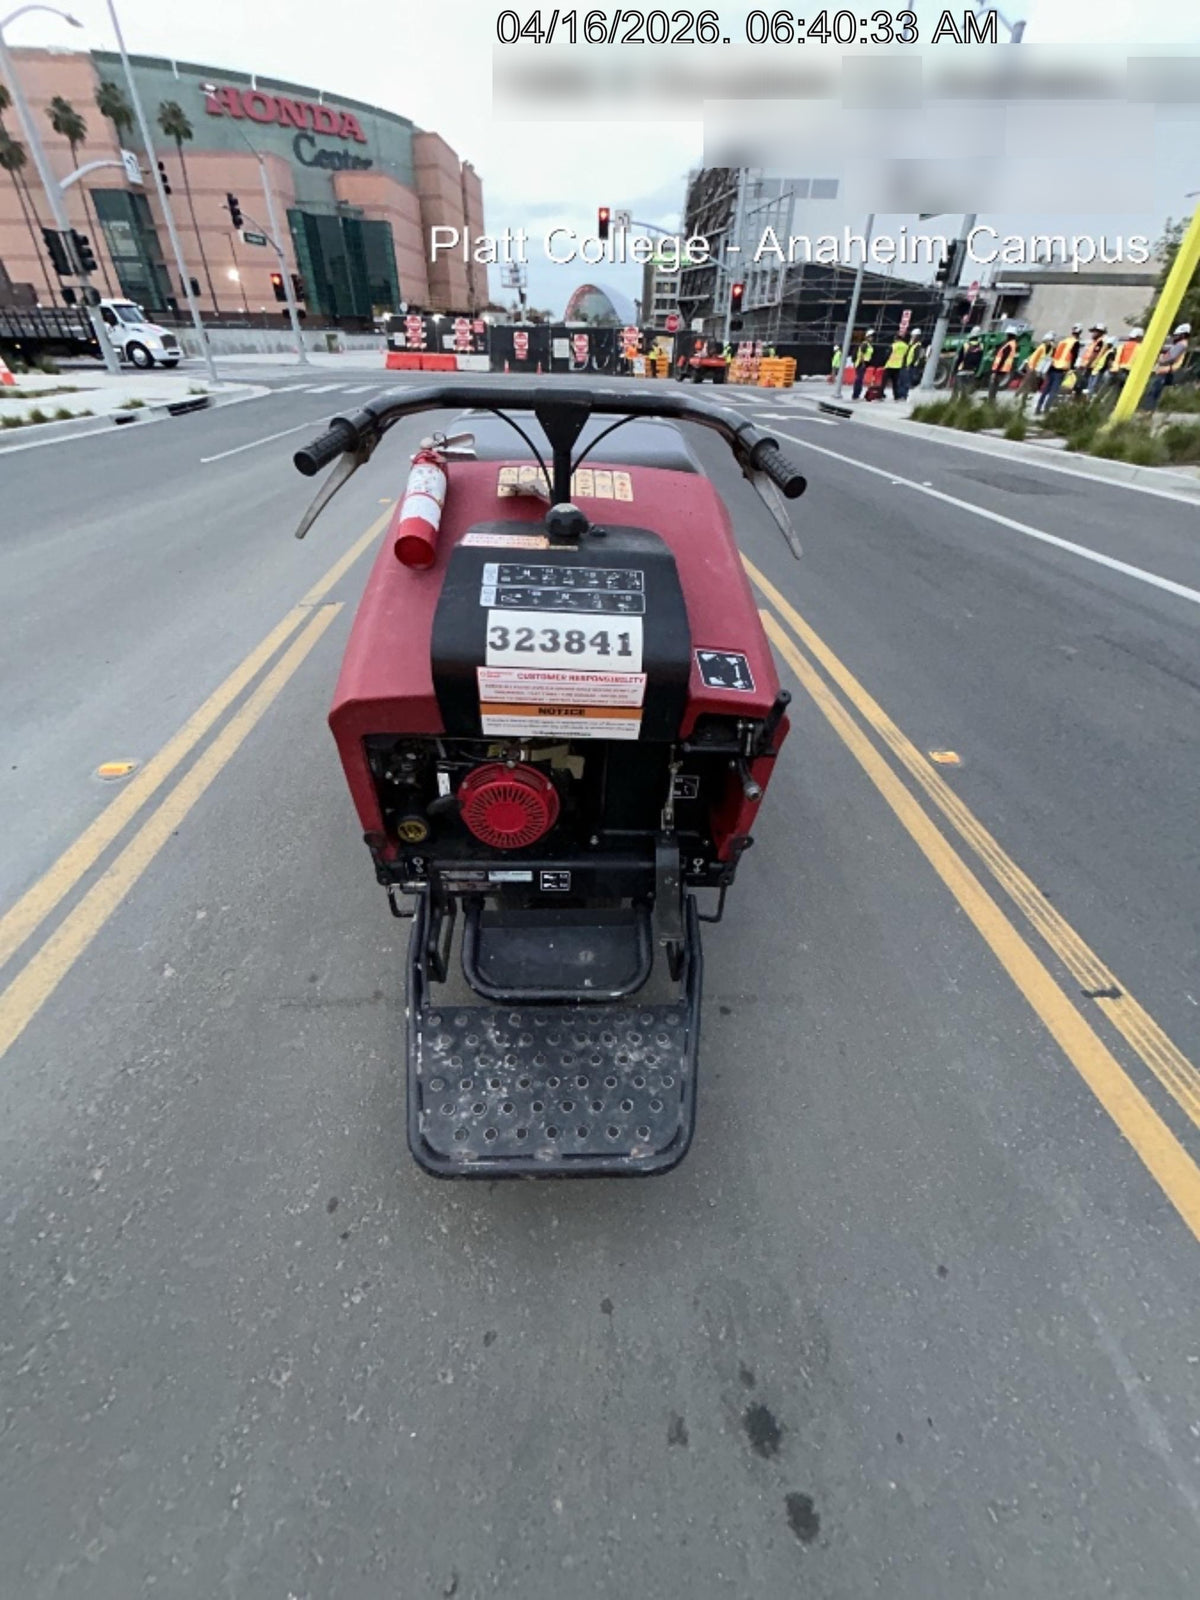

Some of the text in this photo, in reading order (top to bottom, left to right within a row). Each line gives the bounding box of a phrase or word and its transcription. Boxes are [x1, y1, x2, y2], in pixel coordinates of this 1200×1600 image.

[202, 83, 368, 143] HONDA
[293, 132, 373, 170] Center
[488, 626, 632, 657] 323841
[517, 672, 568, 681] CUSTOMER
[569, 675, 644, 684] RESPONSIBILITY
[538, 706, 586, 717] NOTICE
